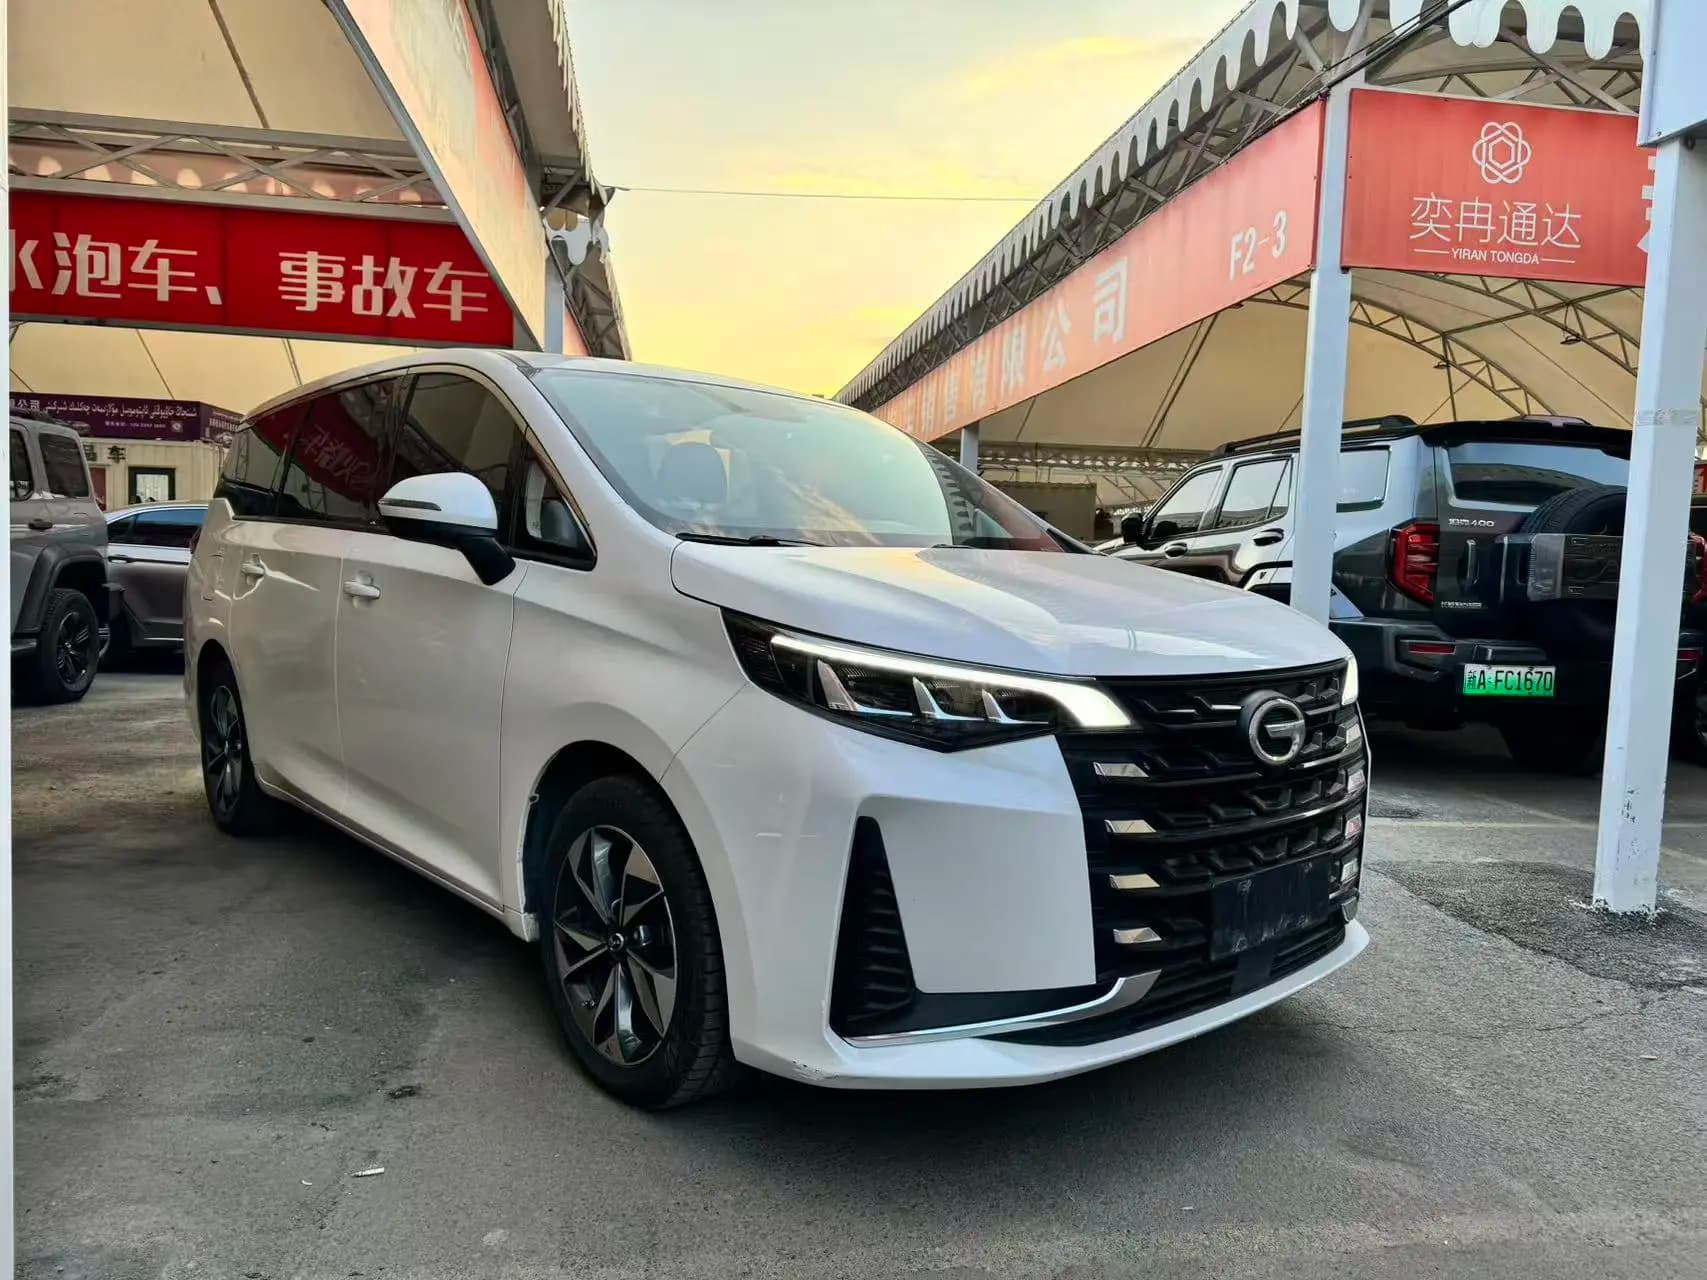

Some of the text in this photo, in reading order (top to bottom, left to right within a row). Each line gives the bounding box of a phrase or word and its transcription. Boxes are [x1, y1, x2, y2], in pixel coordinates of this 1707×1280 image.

[1229, 210, 1288, 281] F2-3
[1409, 192, 1581, 249] 奕冉通达
[1451, 248, 1540, 265] YIRAN TONGDA
